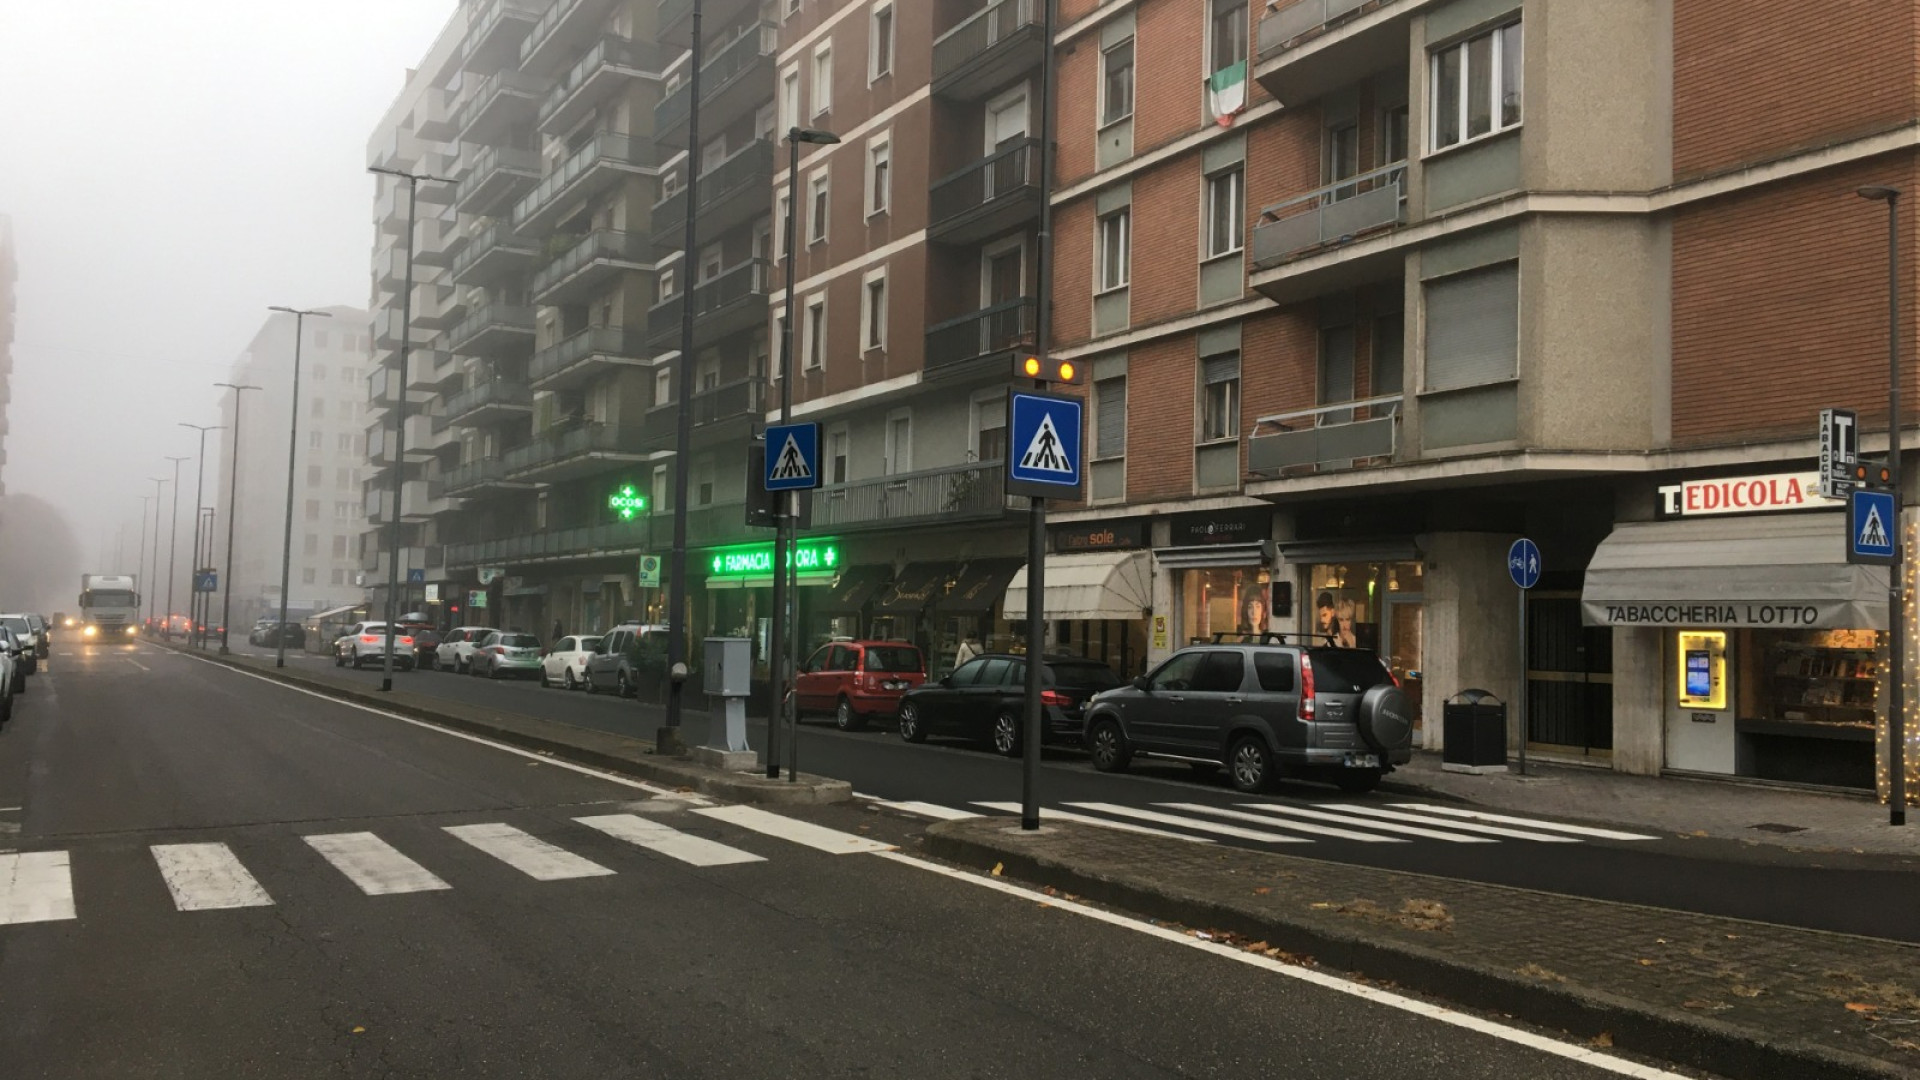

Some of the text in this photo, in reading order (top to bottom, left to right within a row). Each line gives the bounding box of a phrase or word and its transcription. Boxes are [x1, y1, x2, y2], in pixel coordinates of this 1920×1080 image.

[1834, 415, 1853, 463] T
[1821, 413, 1829, 493] TABACCHI
[1686, 478, 1803, 511] EDICOLA
[1089, 528, 1115, 545] sole
[725, 552, 770, 572] FARMACIA
[1605, 605, 1819, 625] TABACCHERIA LOTTO
